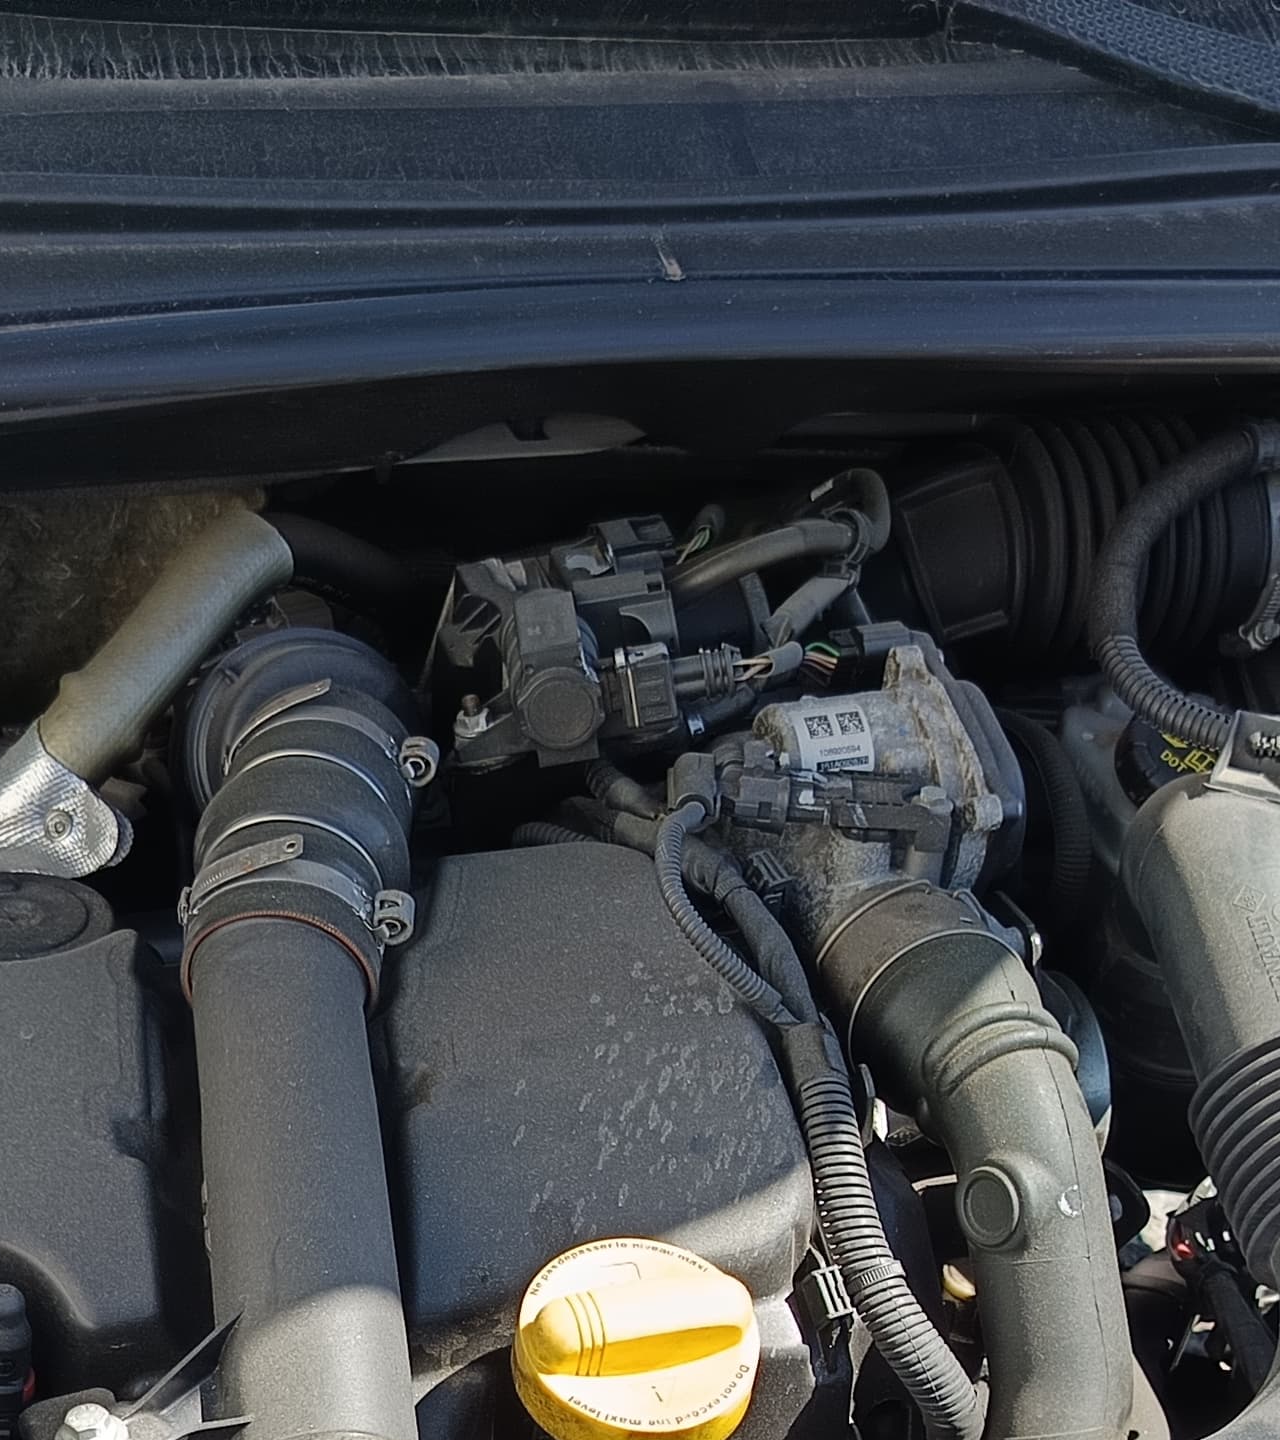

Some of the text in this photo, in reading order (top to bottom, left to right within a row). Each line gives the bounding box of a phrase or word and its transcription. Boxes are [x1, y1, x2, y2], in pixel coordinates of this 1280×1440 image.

[1160, 750, 1188, 772] DOT
[529, 1282, 542, 1296] Ne
[735, 1364, 750, 1379] Do
[719, 1381, 737, 1399] not
[567, 1395, 601, 1418] level
[604, 1411, 642, 1426] maxi
